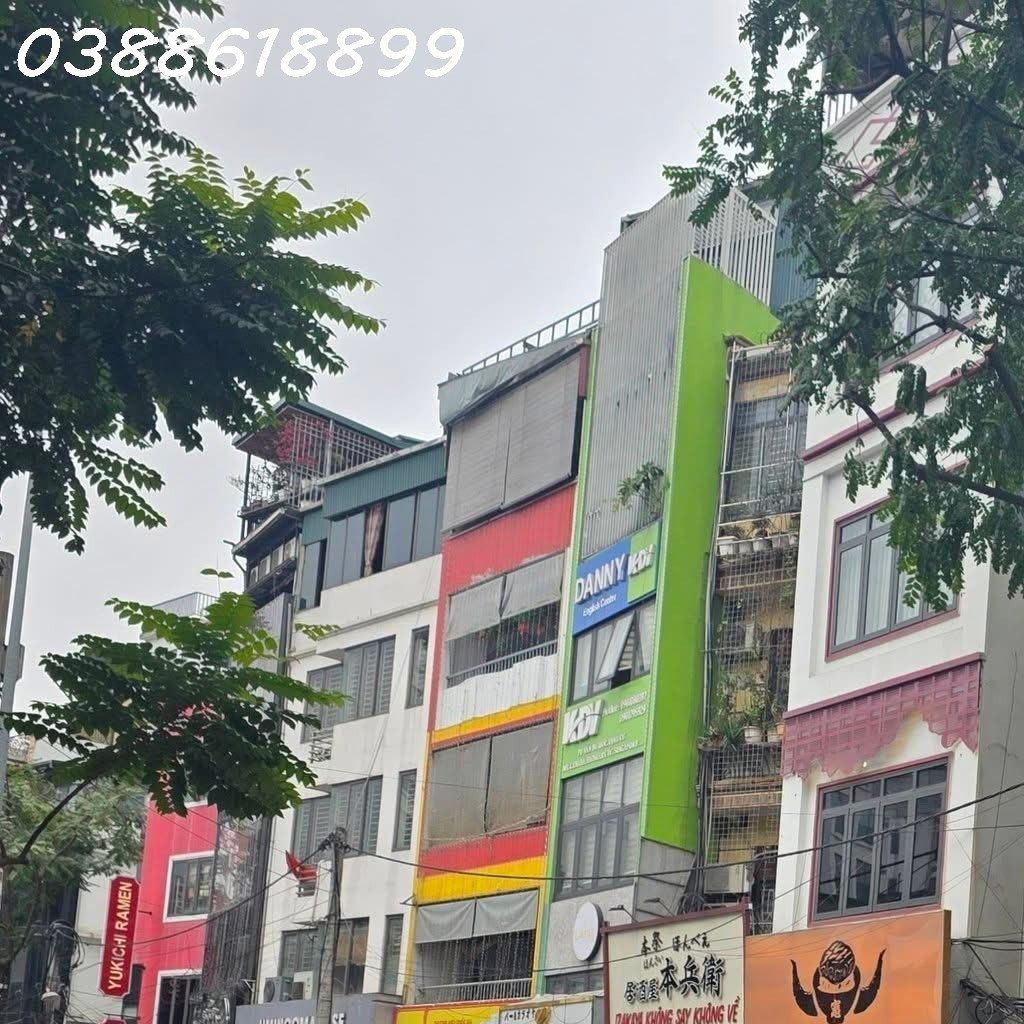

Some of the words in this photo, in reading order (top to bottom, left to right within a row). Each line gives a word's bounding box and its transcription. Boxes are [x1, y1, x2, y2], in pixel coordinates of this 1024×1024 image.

[575, 553, 626, 603] DANNY
[107, 934, 127, 990] YUKICHI
[121, 881, 133, 932] RAMEN
[660, 954, 725, 998] 本兵衛
